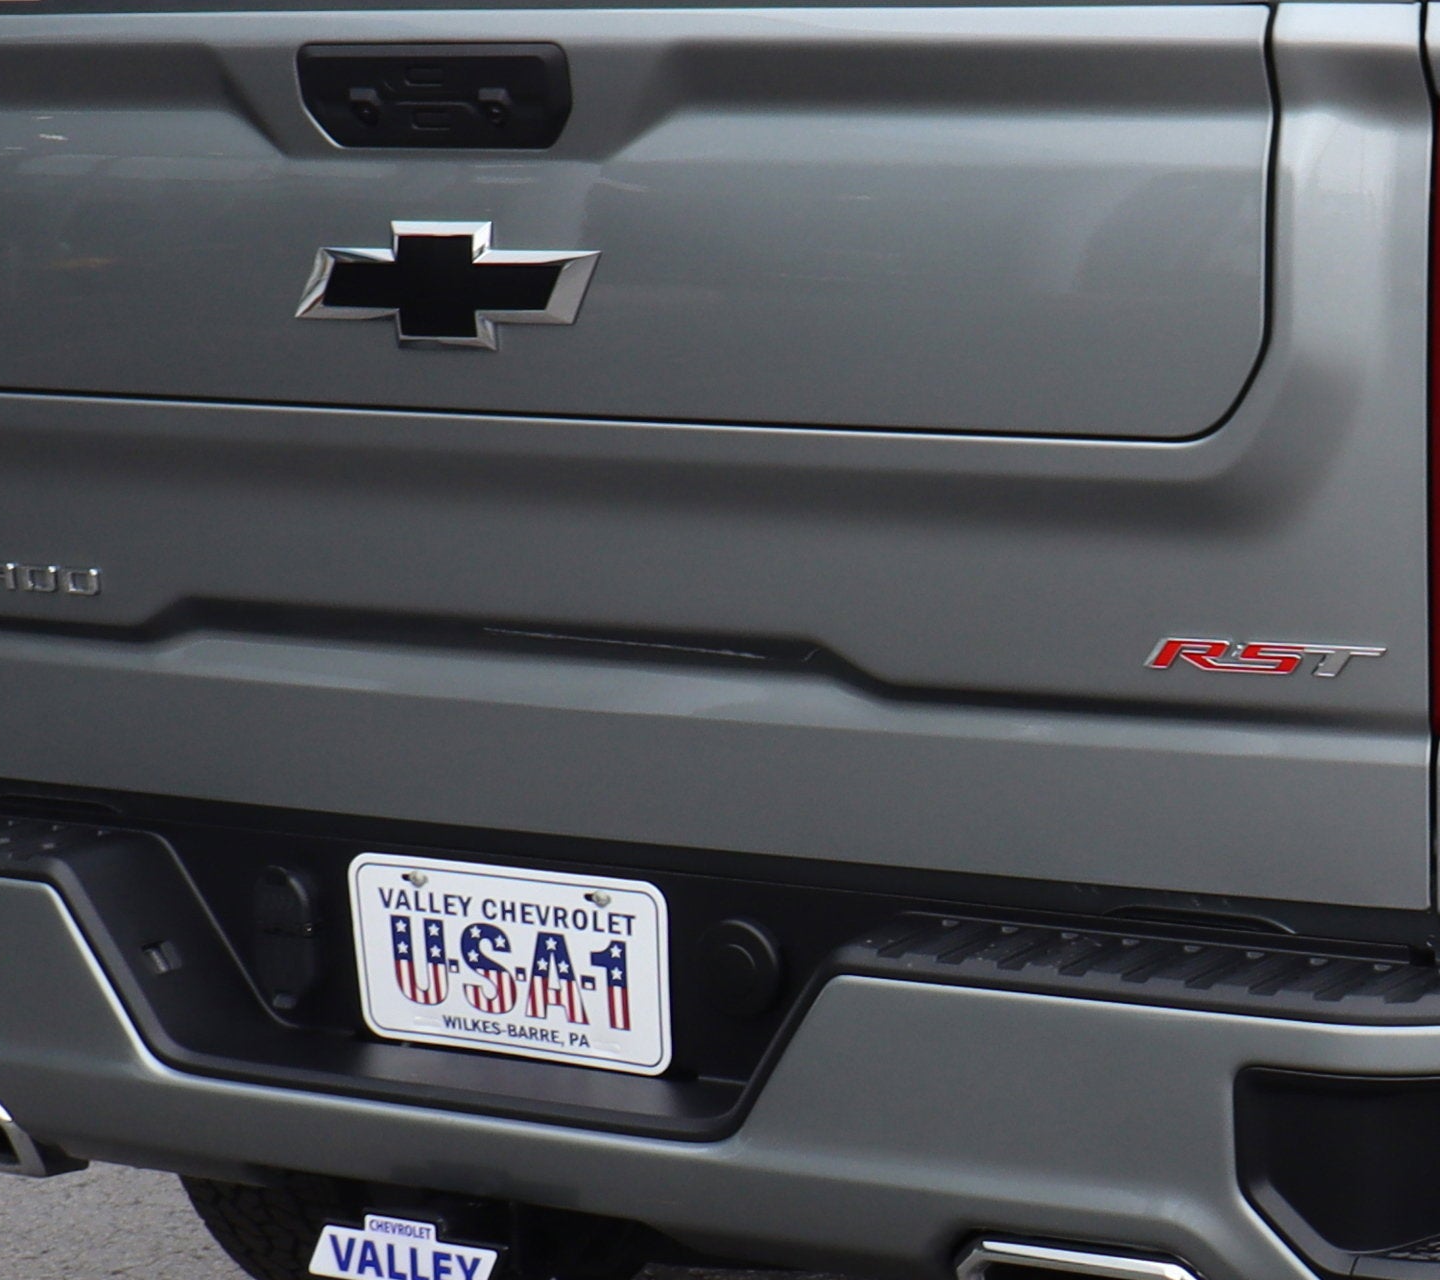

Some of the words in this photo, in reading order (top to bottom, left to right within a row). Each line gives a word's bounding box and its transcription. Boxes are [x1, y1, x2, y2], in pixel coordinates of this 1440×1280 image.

[1144, 637, 1388, 677] RST
[378, 887, 471, 917] VALLEY
[482, 898, 636, 936] CHEVROLET
[442, 1014, 565, 1047] WILKES-BARRE,
[569, 1032, 591, 1048] PA
[369, 1219, 432, 1239] CHEVROLET
